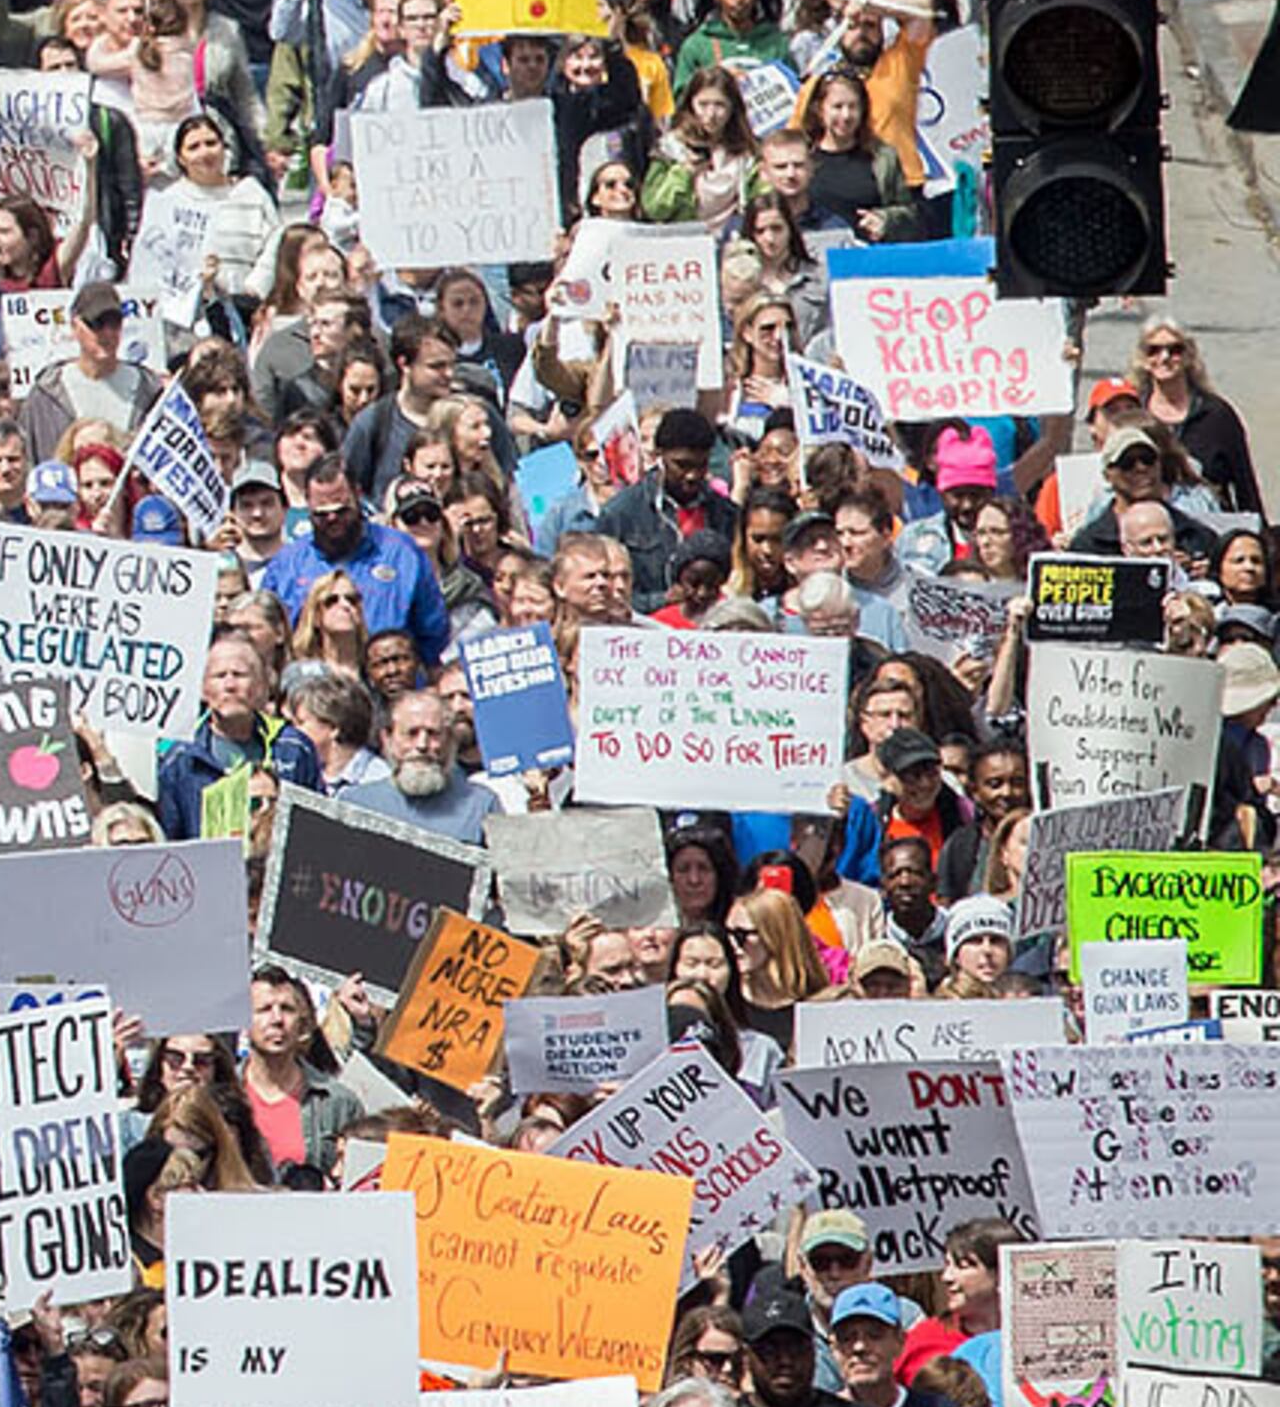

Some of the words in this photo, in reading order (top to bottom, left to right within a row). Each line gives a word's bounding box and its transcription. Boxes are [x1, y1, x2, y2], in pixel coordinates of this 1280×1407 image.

[2, 147, 47, 168] NOT
[402, 221, 440, 255] TO
[460, 214, 540, 256] YOU?
[625, 260, 703, 284] FEAR
[866, 287, 992, 343] Stop
[880, 337, 1031, 385] Killing
[887, 377, 1037, 415] People
[138, 431, 192, 497] LIVES
[28, 545, 109, 591] ONLY
[114, 553, 192, 595] GUNS
[1039, 583, 1114, 605] PEOPLE
[102, 681, 181, 728] BODY
[459, 927, 510, 967] NO
[428, 955, 515, 1007] MORE
[1100, 968, 1170, 989] CHANGE
[1093, 993, 1127, 1015] GUN
[1132, 992, 1180, 1013] LAWS
[418, 1002, 493, 1053] NRA
[847, 1111, 951, 1158] want
[819, 1158, 1009, 1212] Bulletproof
[21, 1195, 129, 1282] GUNS
[174, 1259, 391, 1300] IDEALISM
[1152, 1250, 1224, 1296] I'm
[1123, 1295, 1247, 1373] voting
[178, 1345, 210, 1374] IS
[240, 1345, 286, 1374] MY
